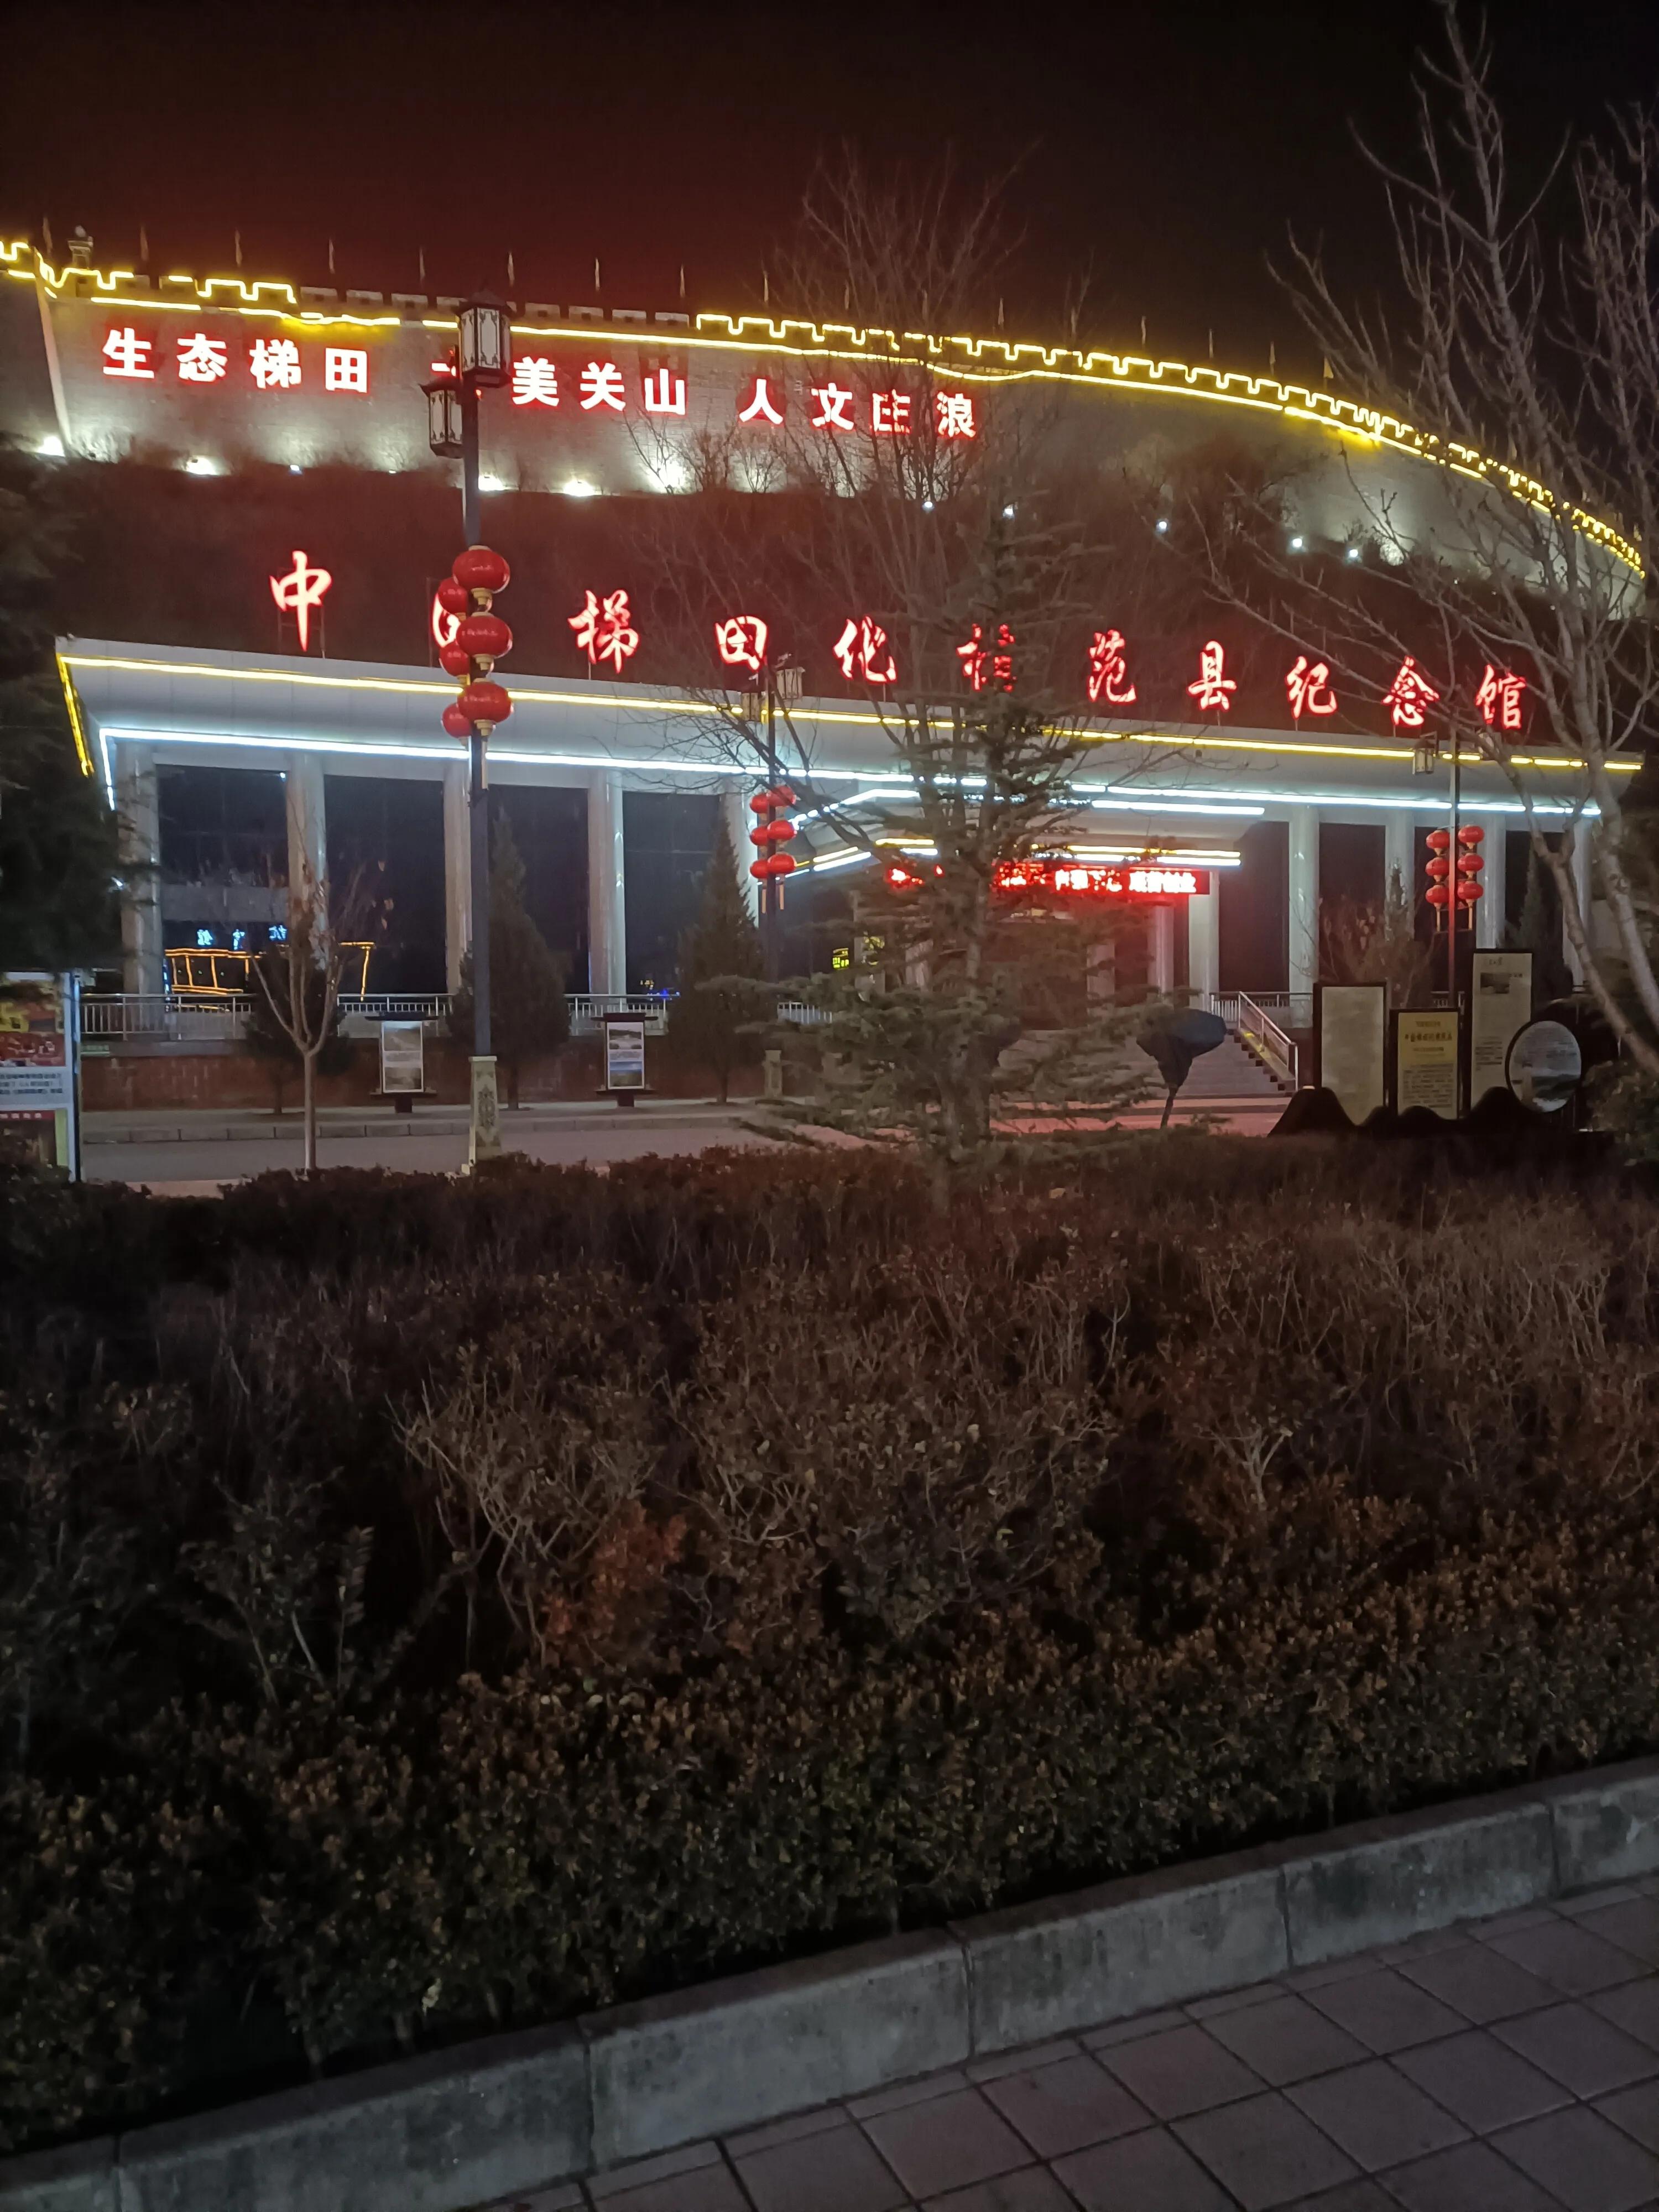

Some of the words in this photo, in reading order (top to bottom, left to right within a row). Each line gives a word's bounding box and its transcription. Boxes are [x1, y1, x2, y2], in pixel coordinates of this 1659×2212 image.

[102, 326, 368, 393] 生态梯田
[431, 349, 686, 417] 美关山
[738, 377, 977, 439] 人文庄浪
